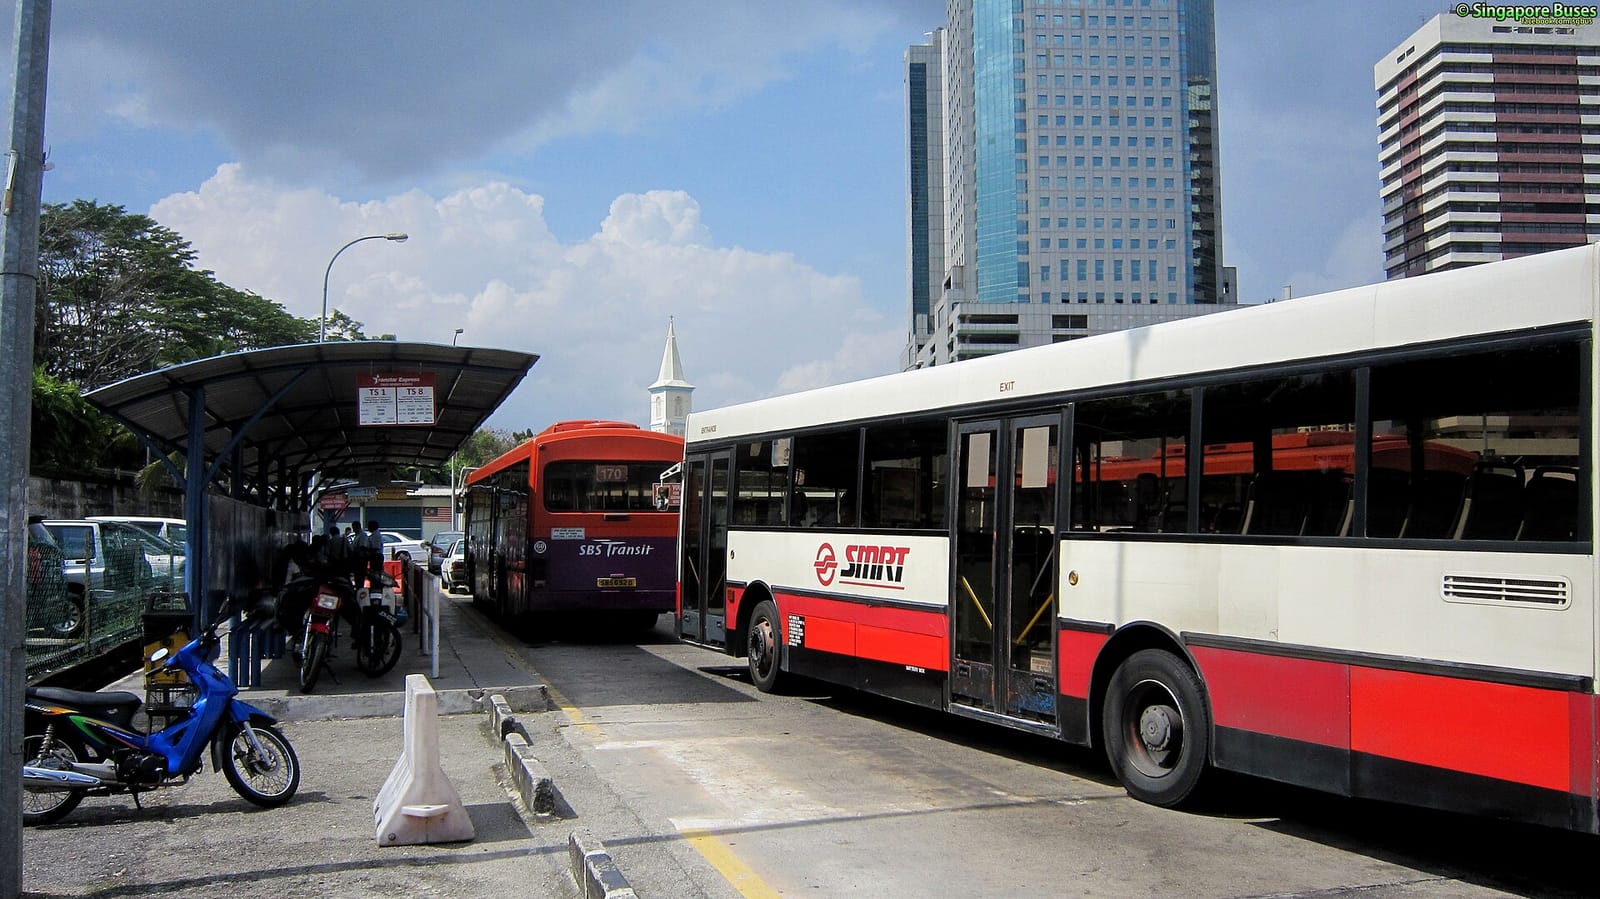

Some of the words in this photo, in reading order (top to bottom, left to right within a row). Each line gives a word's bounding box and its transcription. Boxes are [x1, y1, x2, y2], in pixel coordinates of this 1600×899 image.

[369, 388, 379, 396] TS
[381, 388, 386, 396] 1
[407, 388, 417, 396] TS
[1000, 381, 1015, 392] EXIT
[600, 468, 622, 480] 170
[579, 544, 602, 556] SBS
[600, 541, 655, 557] Transit
[840, 545, 910, 583] SMRT
